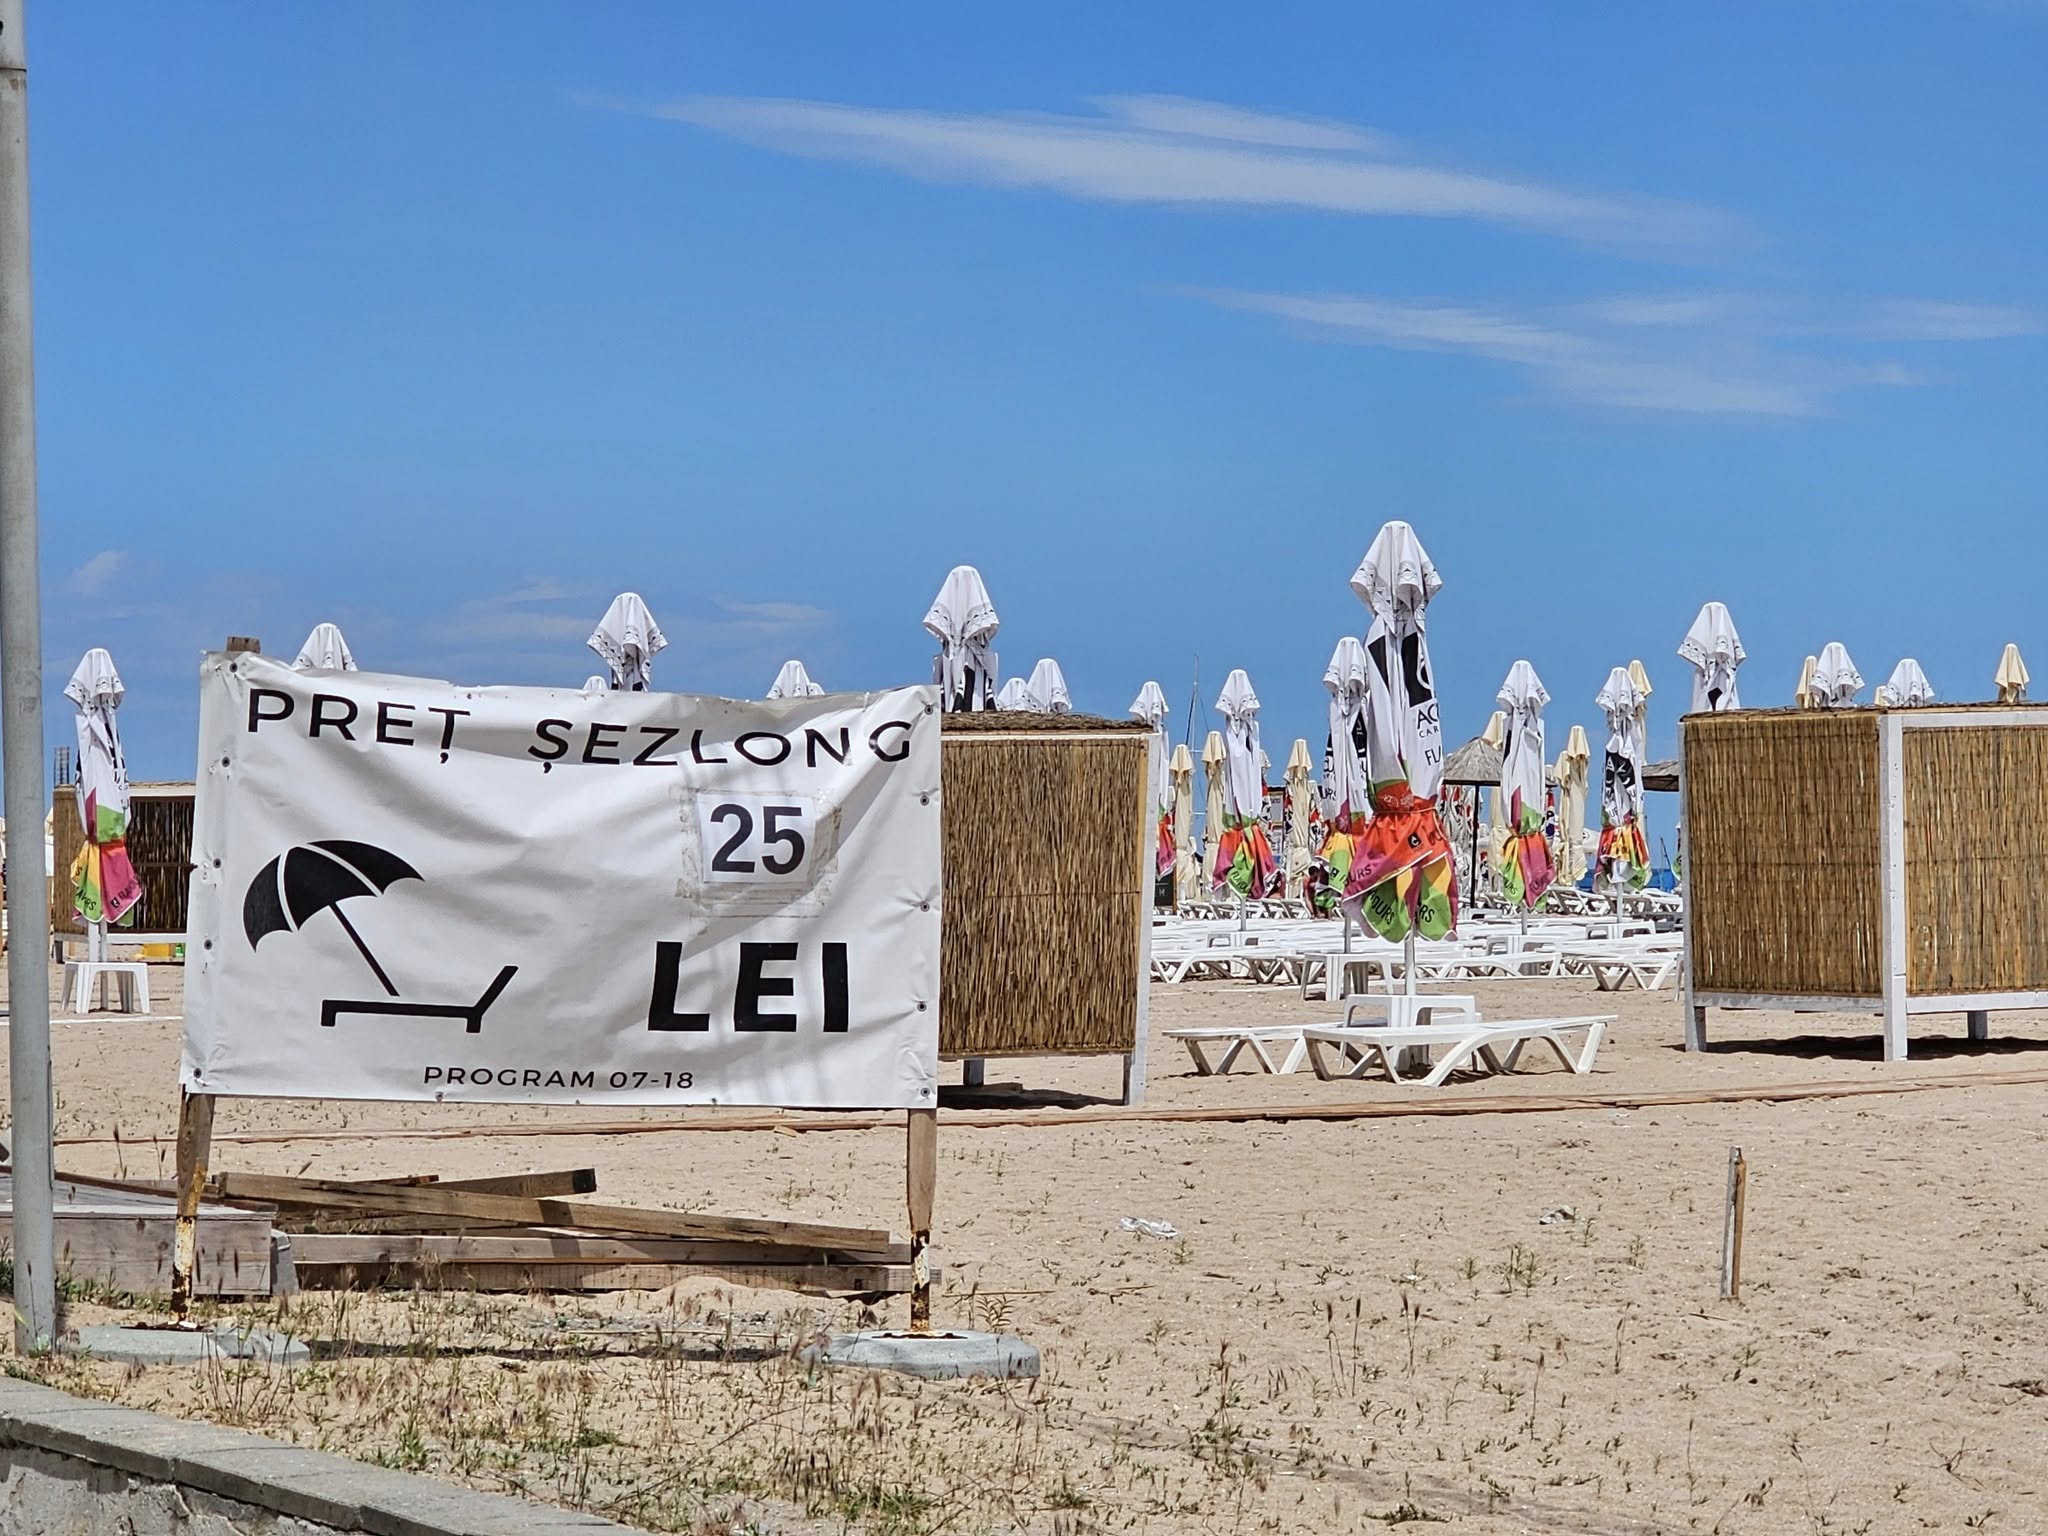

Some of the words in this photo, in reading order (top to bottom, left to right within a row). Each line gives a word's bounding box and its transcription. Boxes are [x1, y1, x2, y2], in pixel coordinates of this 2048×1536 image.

[247, 687, 471, 765] PREȚ
[527, 718, 913, 774] ȘEZLONG
[710, 803, 806, 875] 25
[647, 940, 849, 1033] LEI
[423, 1066, 596, 1089] PROGRAM
[609, 1071, 694, 1089] 07-18
